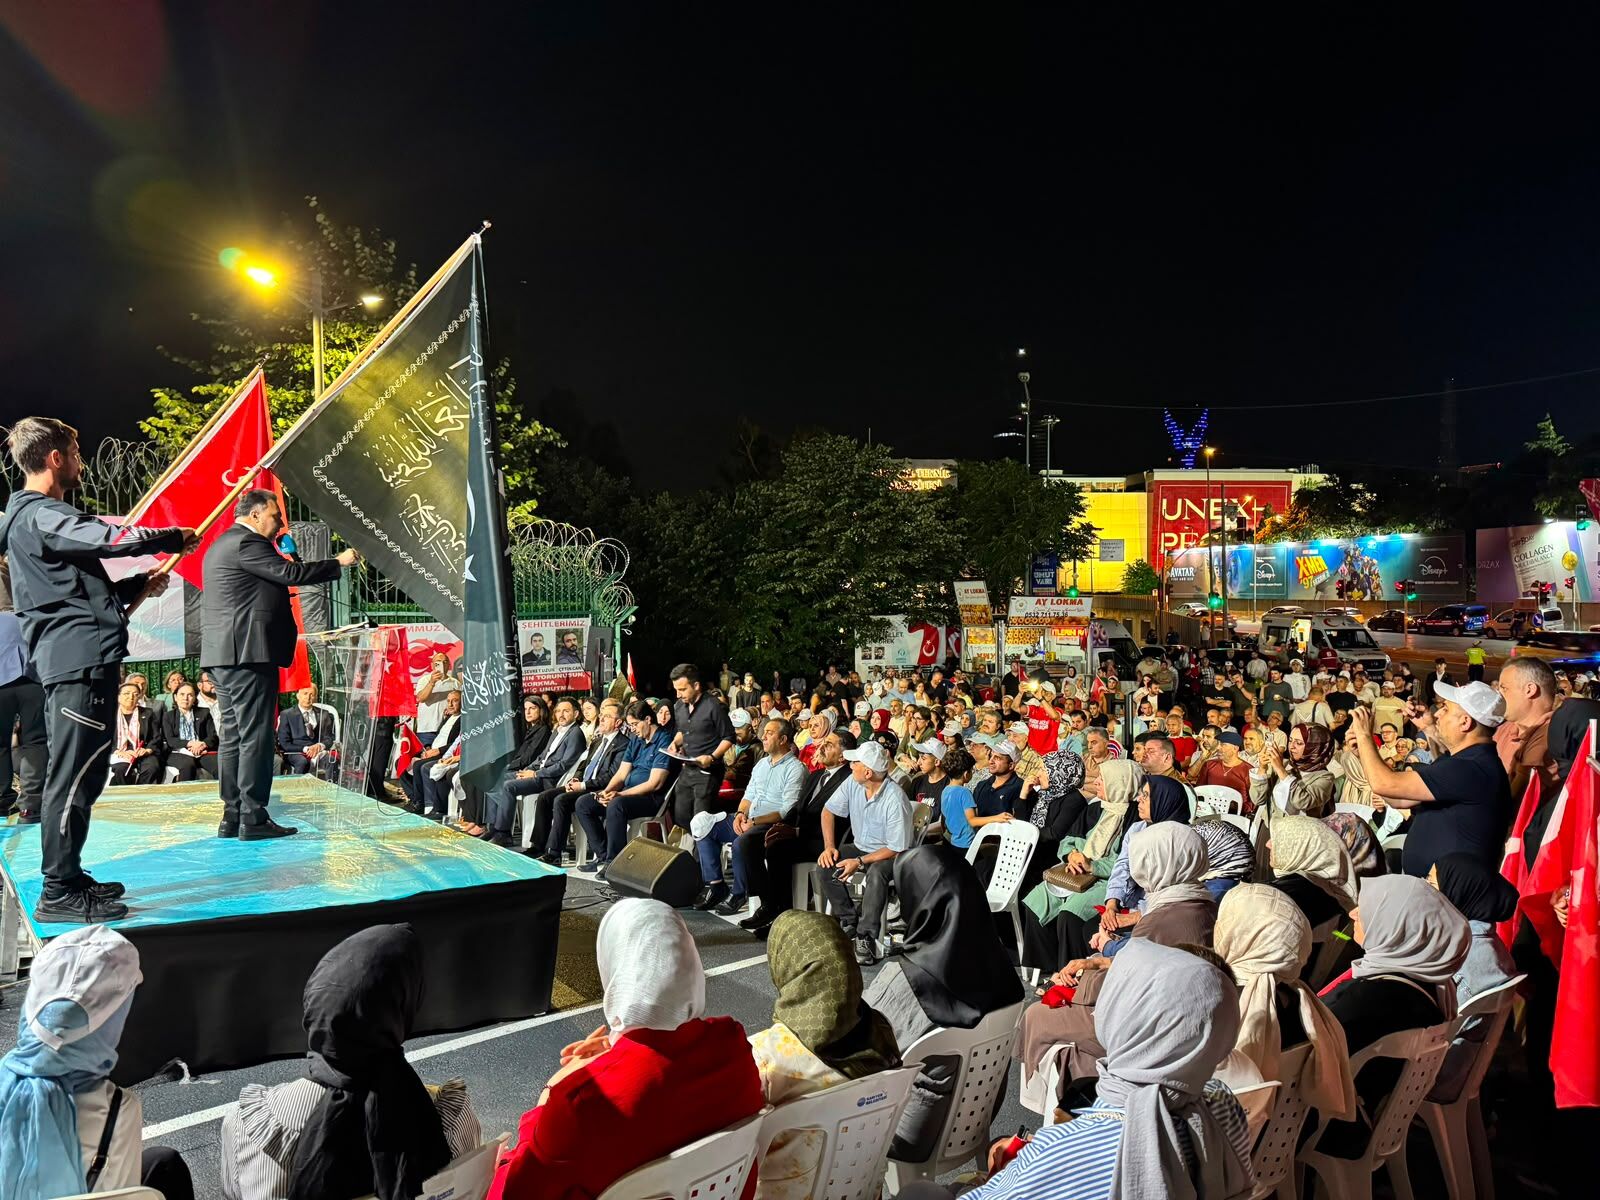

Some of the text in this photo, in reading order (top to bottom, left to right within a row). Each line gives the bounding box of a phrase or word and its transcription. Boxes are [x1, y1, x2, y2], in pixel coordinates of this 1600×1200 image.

[1514, 544, 1554, 563] COLLAGEN
[1170, 567, 1195, 577] AVATAR
[1418, 563, 1448, 578] Disney+
[1035, 598, 1083, 606] AY LOKMA
[522, 620, 585, 629] ŞEHİTLERİMİZ
